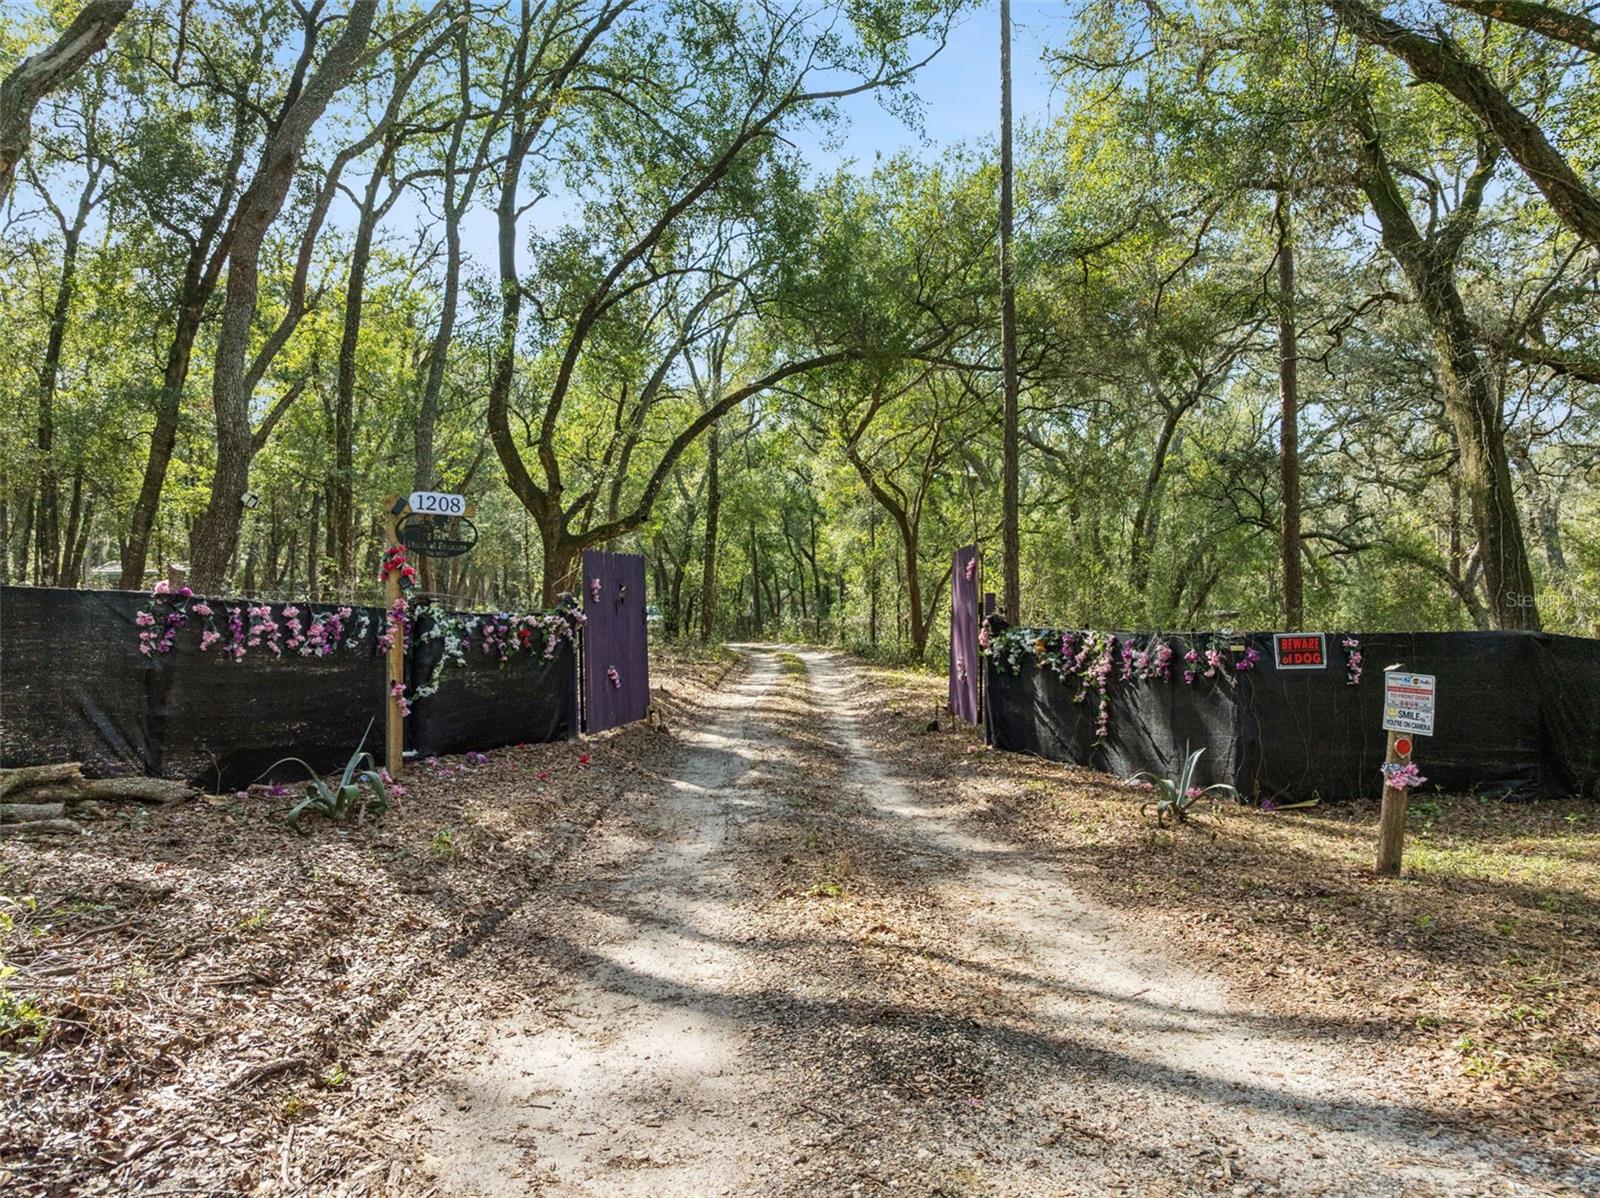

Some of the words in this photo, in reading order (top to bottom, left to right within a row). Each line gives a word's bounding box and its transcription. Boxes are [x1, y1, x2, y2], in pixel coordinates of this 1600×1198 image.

[416, 494, 461, 513] 1208
[1281, 637, 1320, 650] BEWARE
[1282, 653, 1292, 664] of
[1294, 652, 1321, 664] DOG
[1398, 709, 1420, 721] SMILE
[1386, 719, 1402, 728] YOU'RE
[1411, 722, 1430, 731] CAMERA
